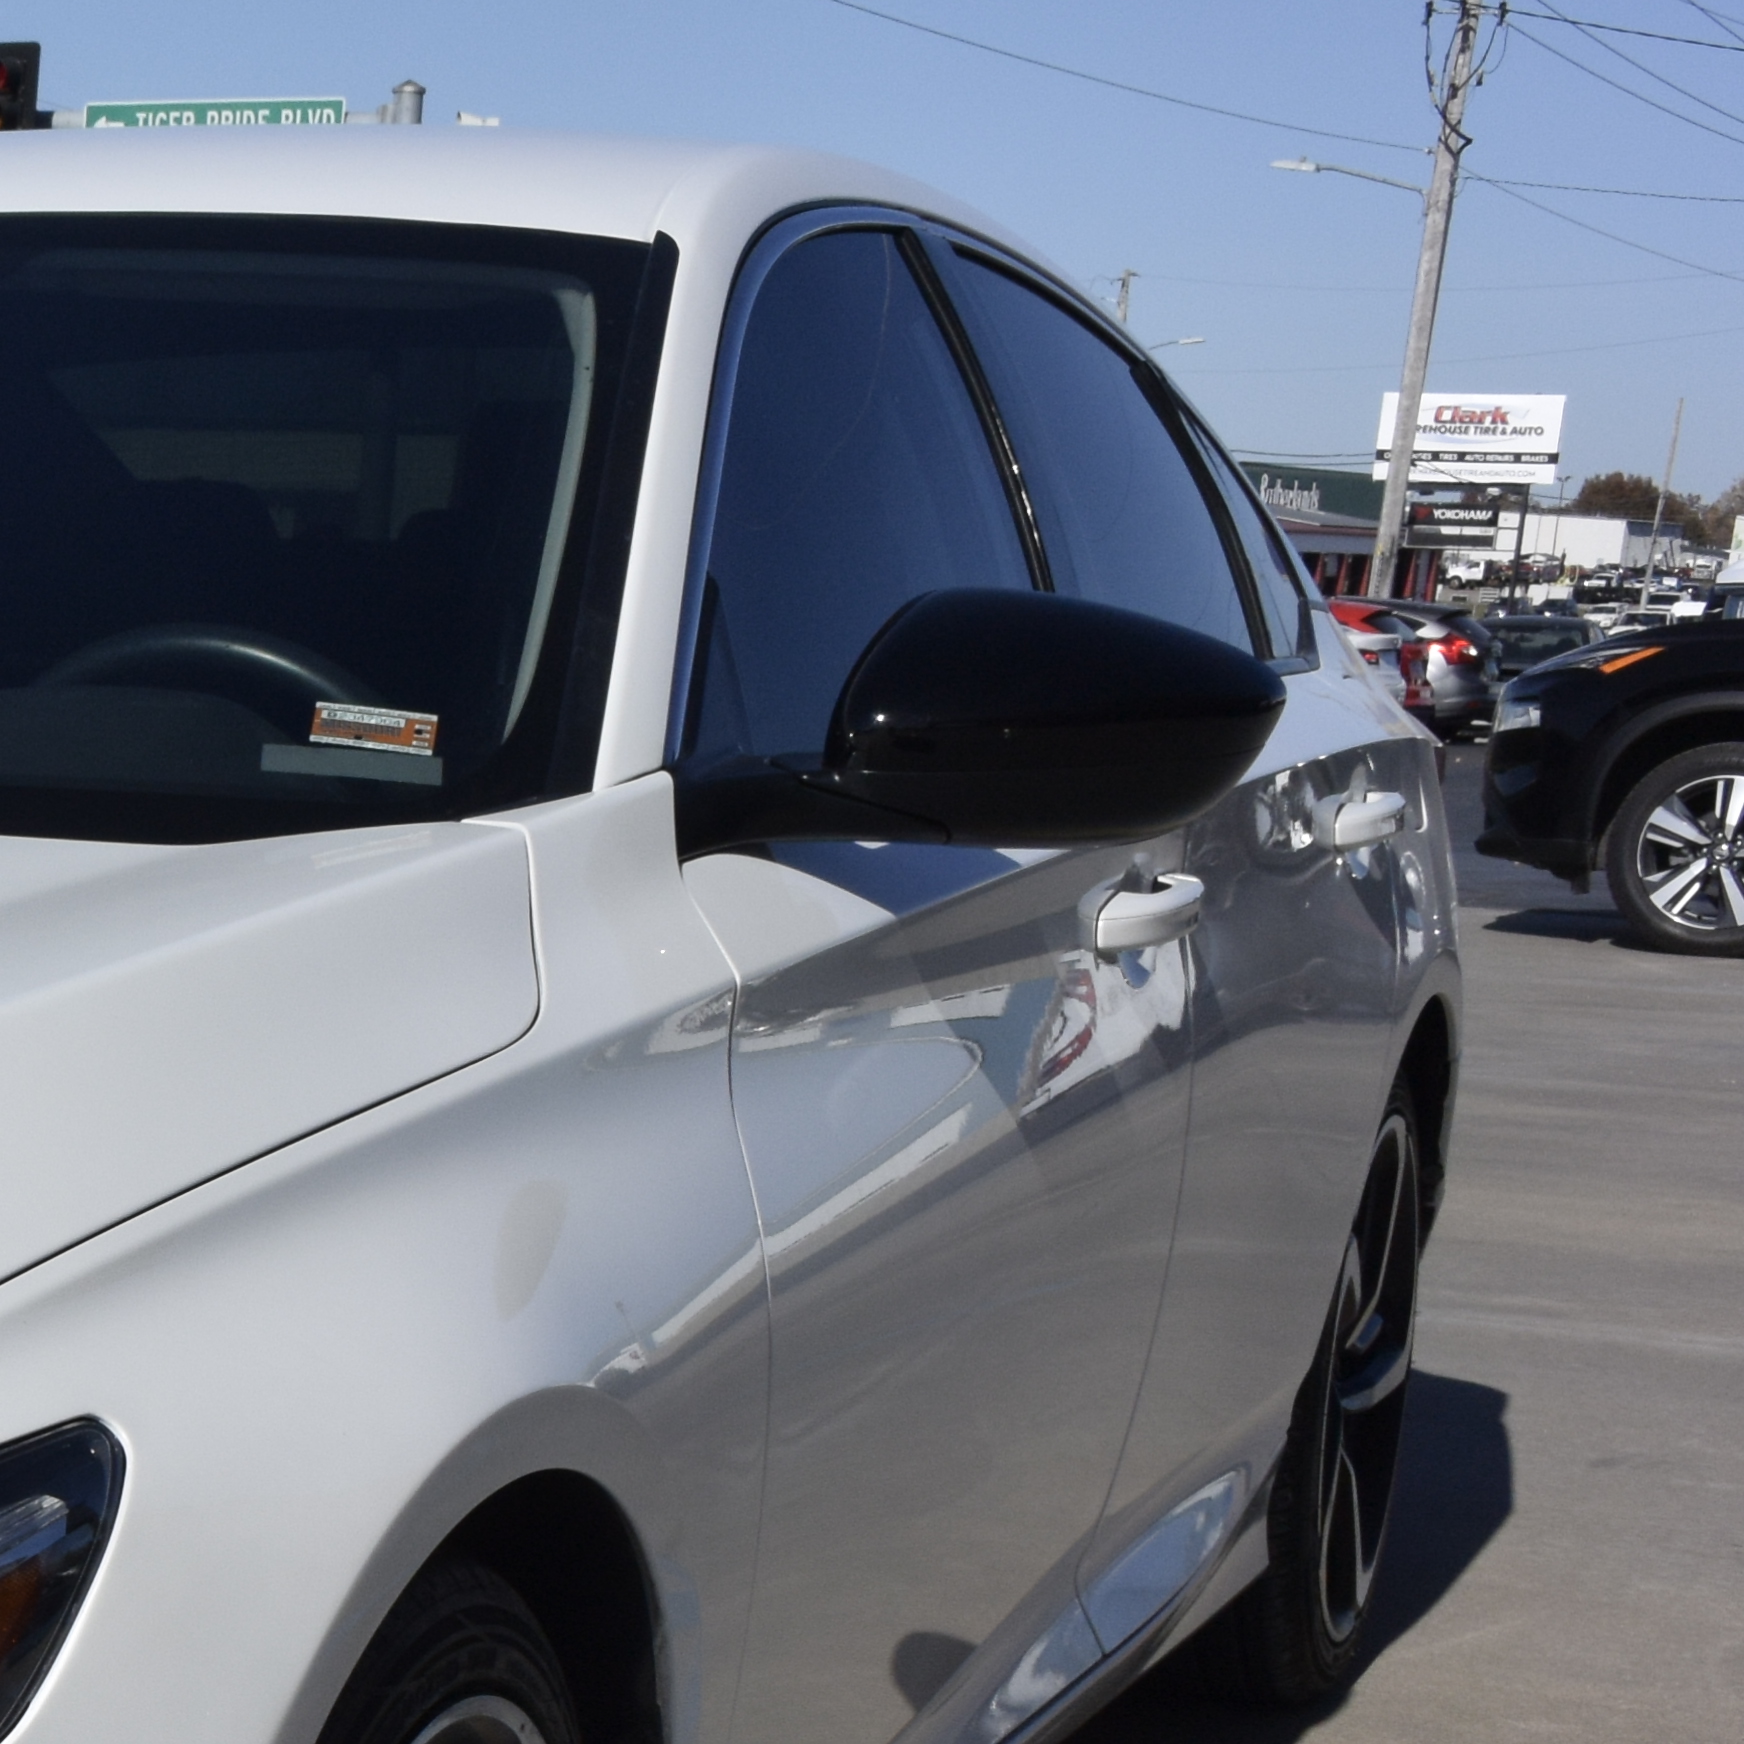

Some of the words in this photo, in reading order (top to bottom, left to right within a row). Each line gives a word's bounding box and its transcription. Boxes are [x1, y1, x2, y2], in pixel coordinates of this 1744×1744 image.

[1433, 405, 1509, 425] Clark
[1415, 424, 1469, 435] REHOUSE
[1473, 425, 1499, 436] TIRE
[1500, 428, 1507, 436] &
[1510, 426, 1544, 436] AUTO
[1433, 508, 1493, 520] YOKOHAMA
